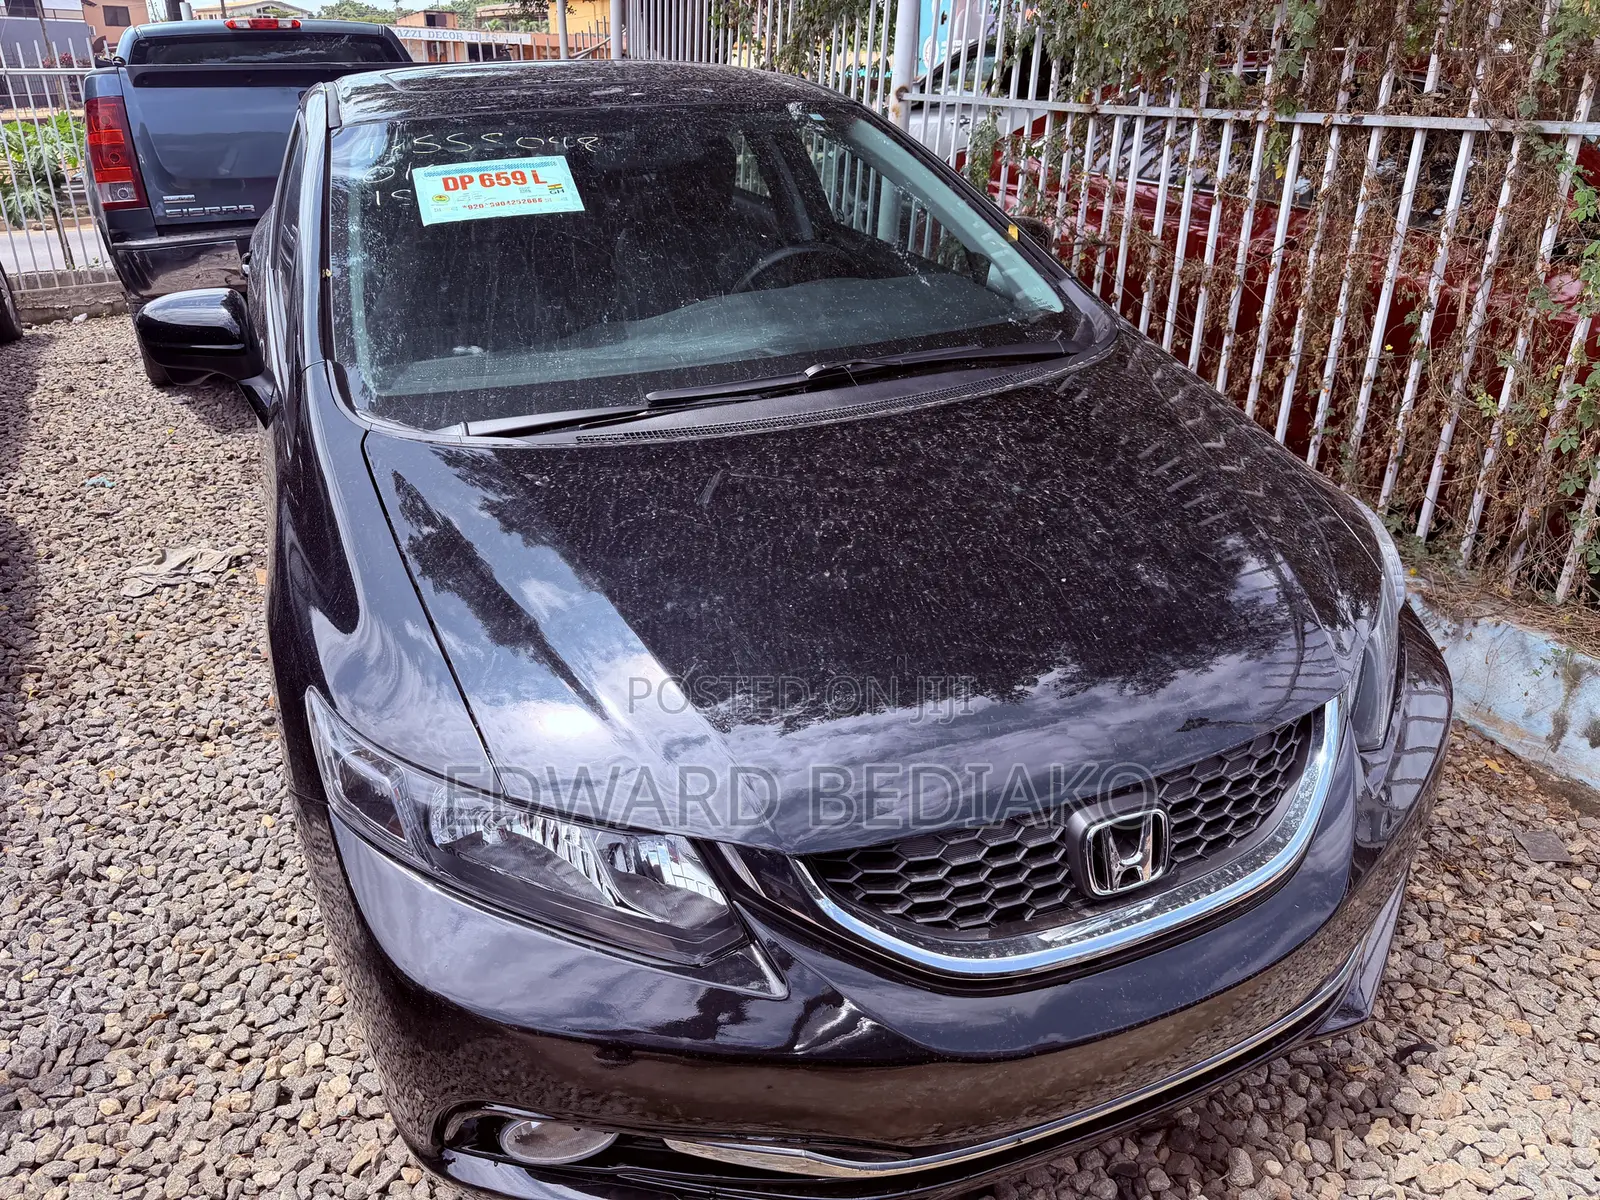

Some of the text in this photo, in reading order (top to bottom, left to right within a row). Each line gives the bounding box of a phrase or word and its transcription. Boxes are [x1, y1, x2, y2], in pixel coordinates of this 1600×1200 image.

[428, 31, 464, 40] DECOR
[442, 169, 548, 191] DP 659 L
[165, 204, 256, 218] SIERRA
